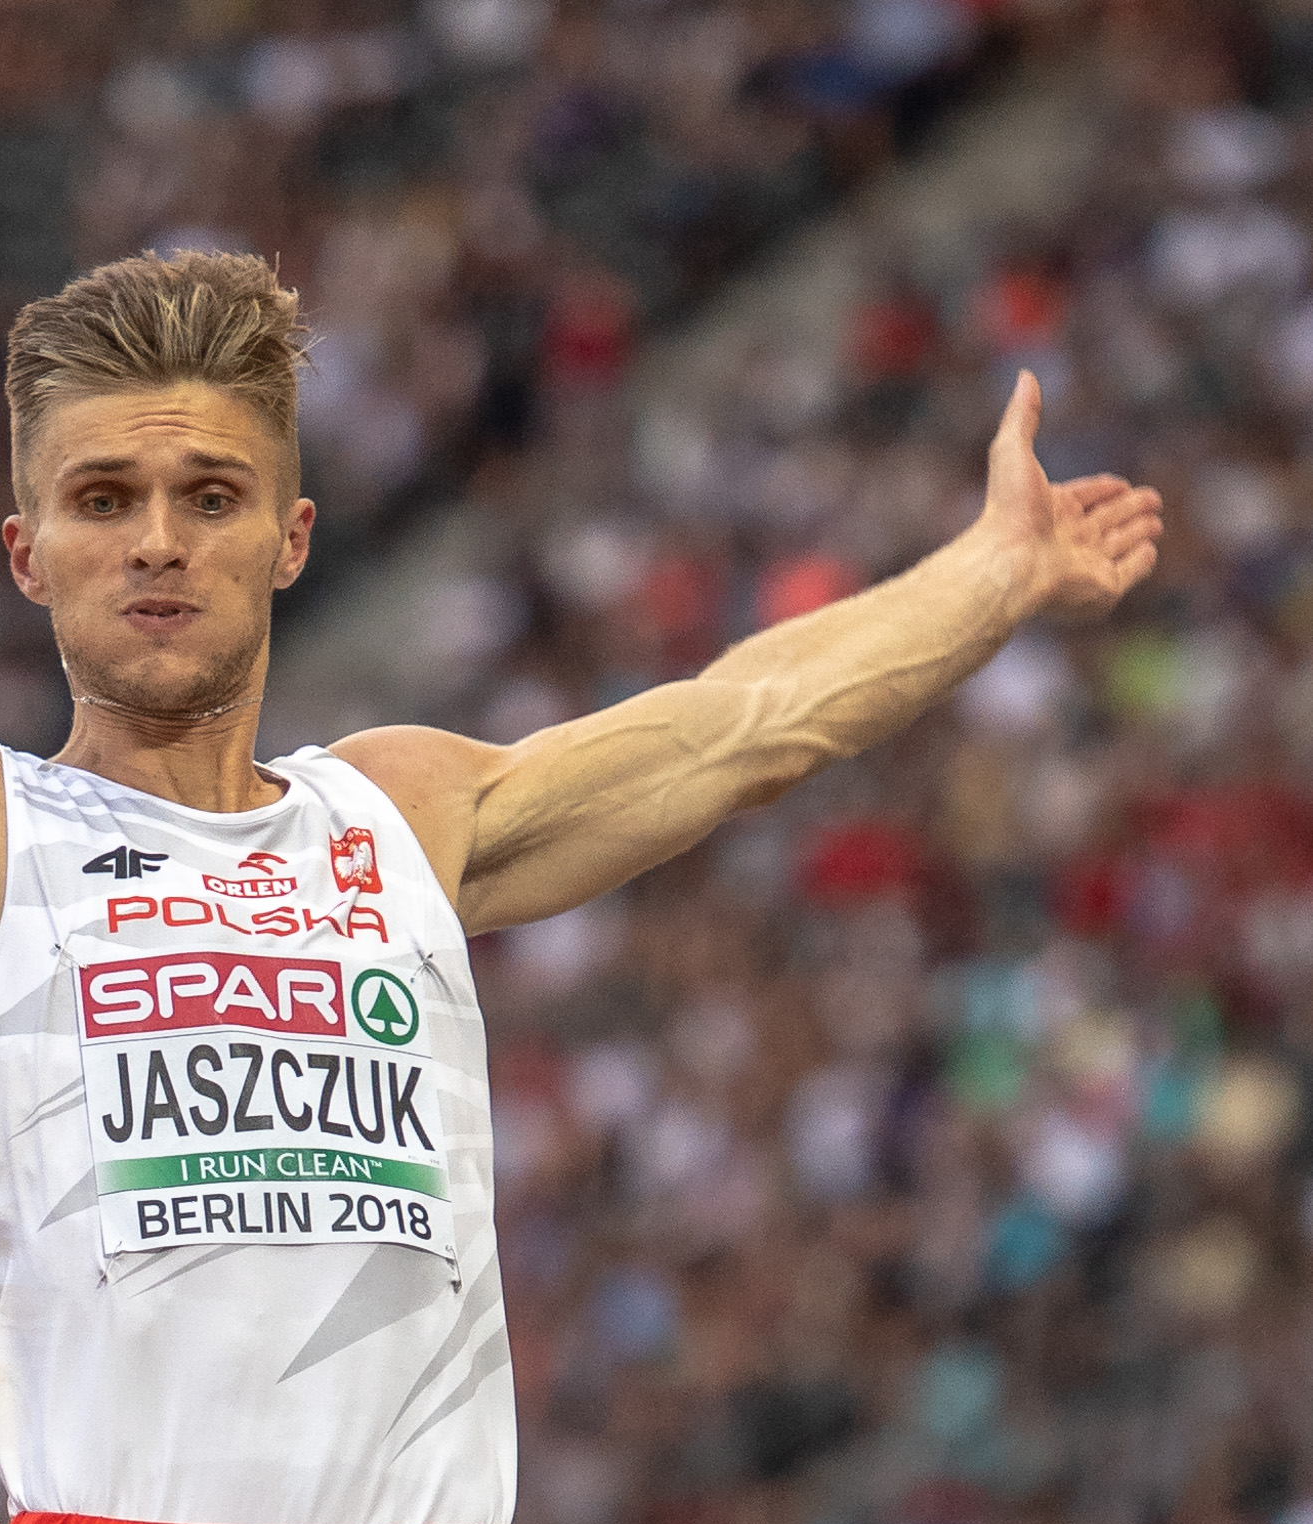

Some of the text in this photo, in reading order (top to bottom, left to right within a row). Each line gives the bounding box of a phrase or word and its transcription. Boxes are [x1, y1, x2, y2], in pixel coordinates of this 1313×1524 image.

[82, 846, 169, 879] 4F
[208, 877, 293, 896] ORLEN
[107, 895, 389, 943] POLSKA
[89, 962, 339, 1025] SPAR
[102, 1043, 435, 1152] JASZCZUK
[181, 1159, 188, 1181] I
[199, 1153, 265, 1179] RUN
[137, 1192, 432, 1240] BERLIN 2018
